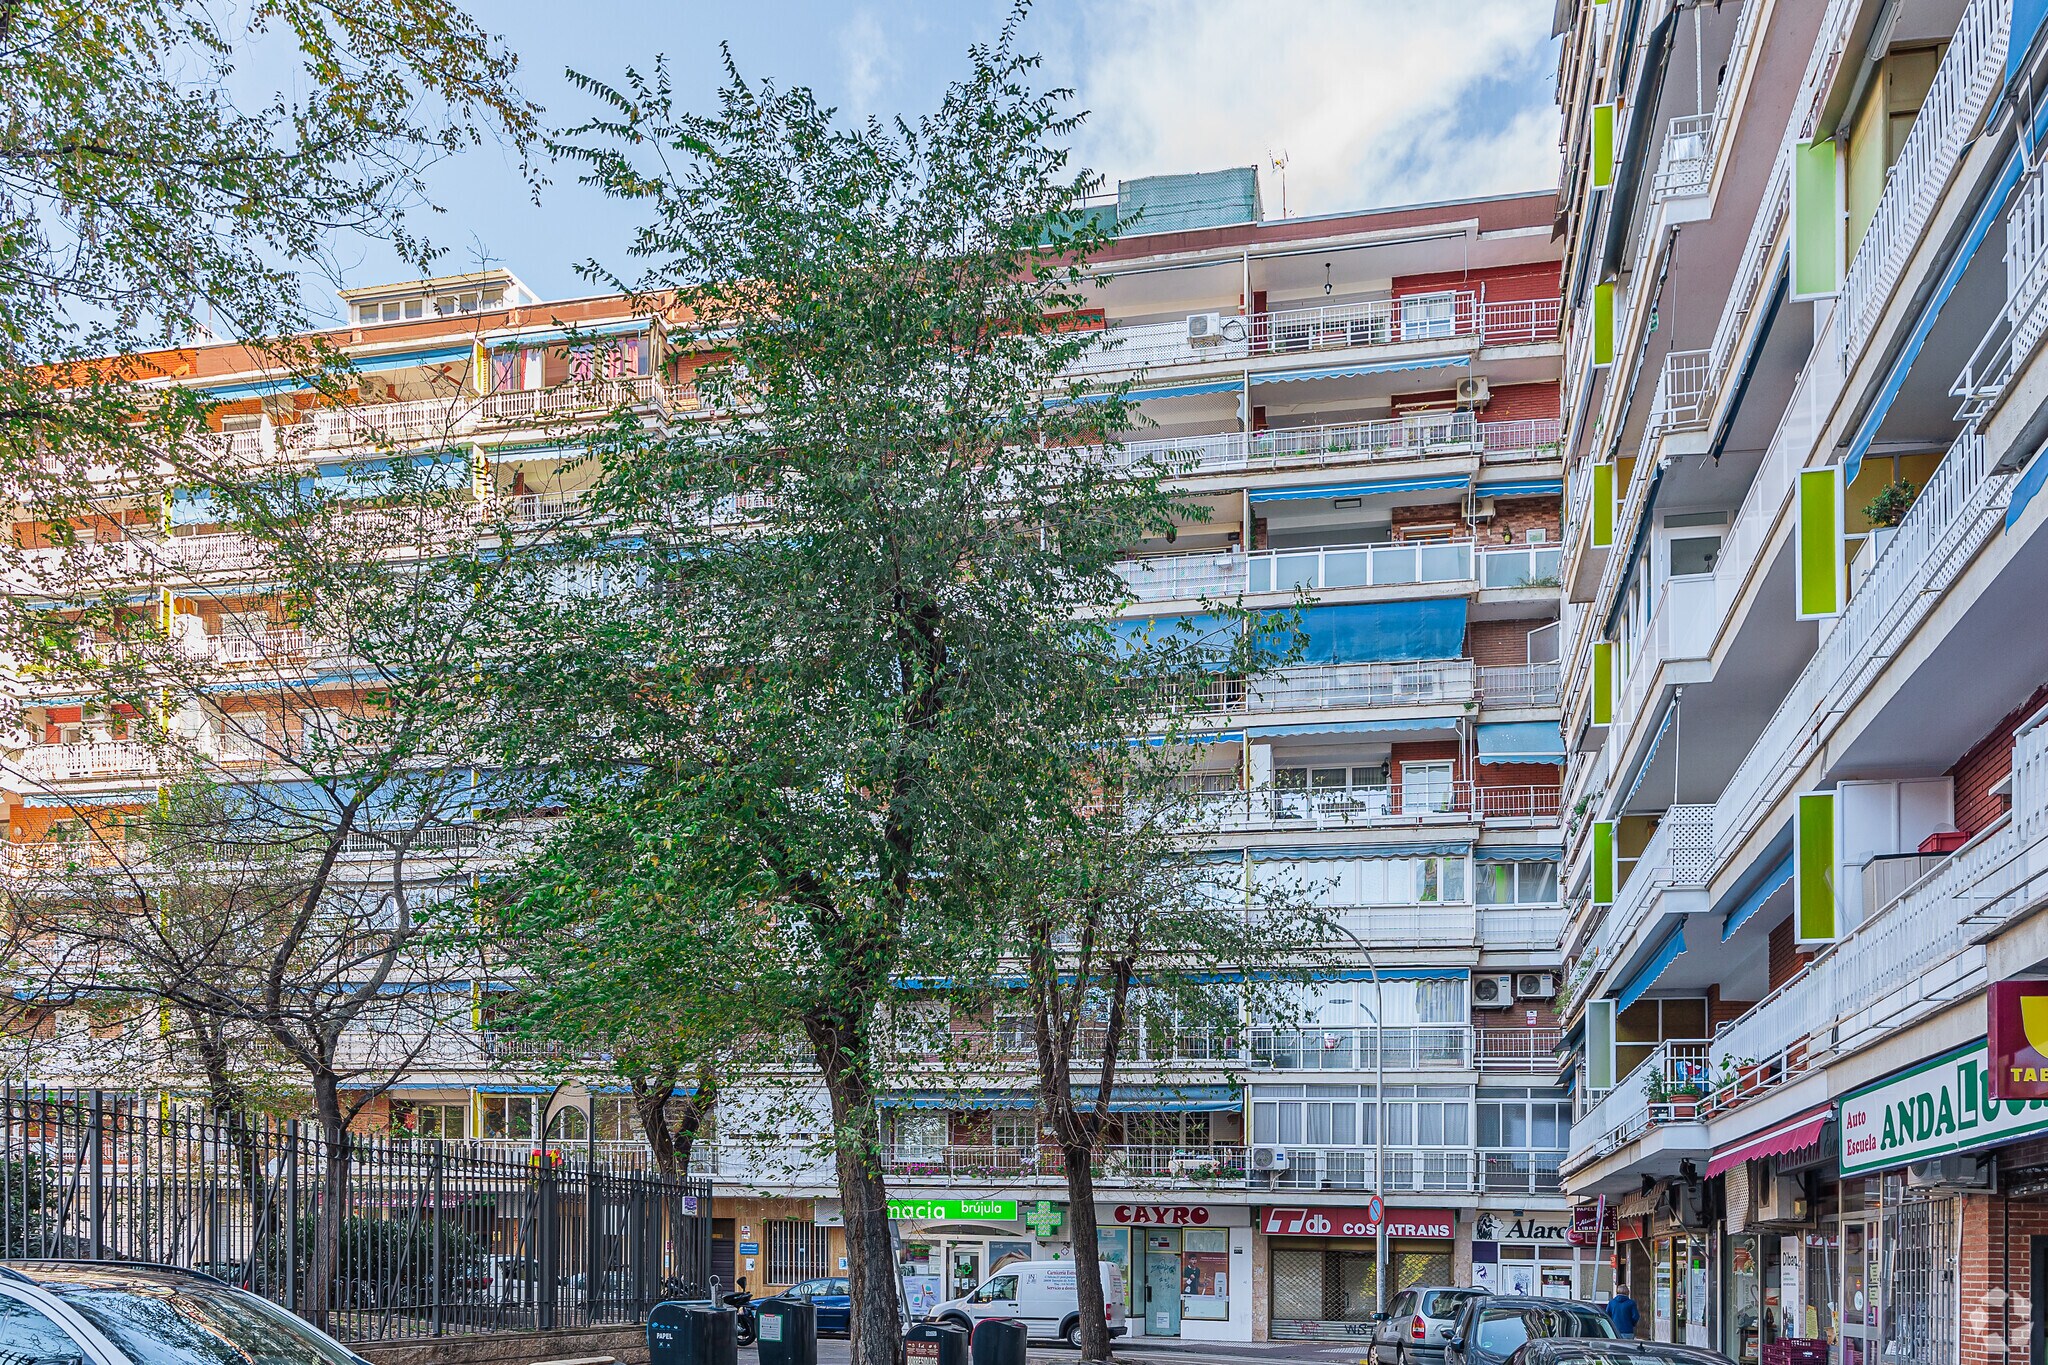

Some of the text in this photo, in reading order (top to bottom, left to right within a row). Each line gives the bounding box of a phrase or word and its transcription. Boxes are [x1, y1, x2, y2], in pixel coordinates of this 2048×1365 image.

[1847, 1111, 1867, 1129] Auto
[1847, 1133, 1877, 1156] Escuela
[961, 1200, 1002, 1216] brújula
[1114, 1204, 1210, 1225] CAYRO
[1343, 1222, 1450, 1237] COSATRANS
[656, 1332, 673, 1340] PAPEL
